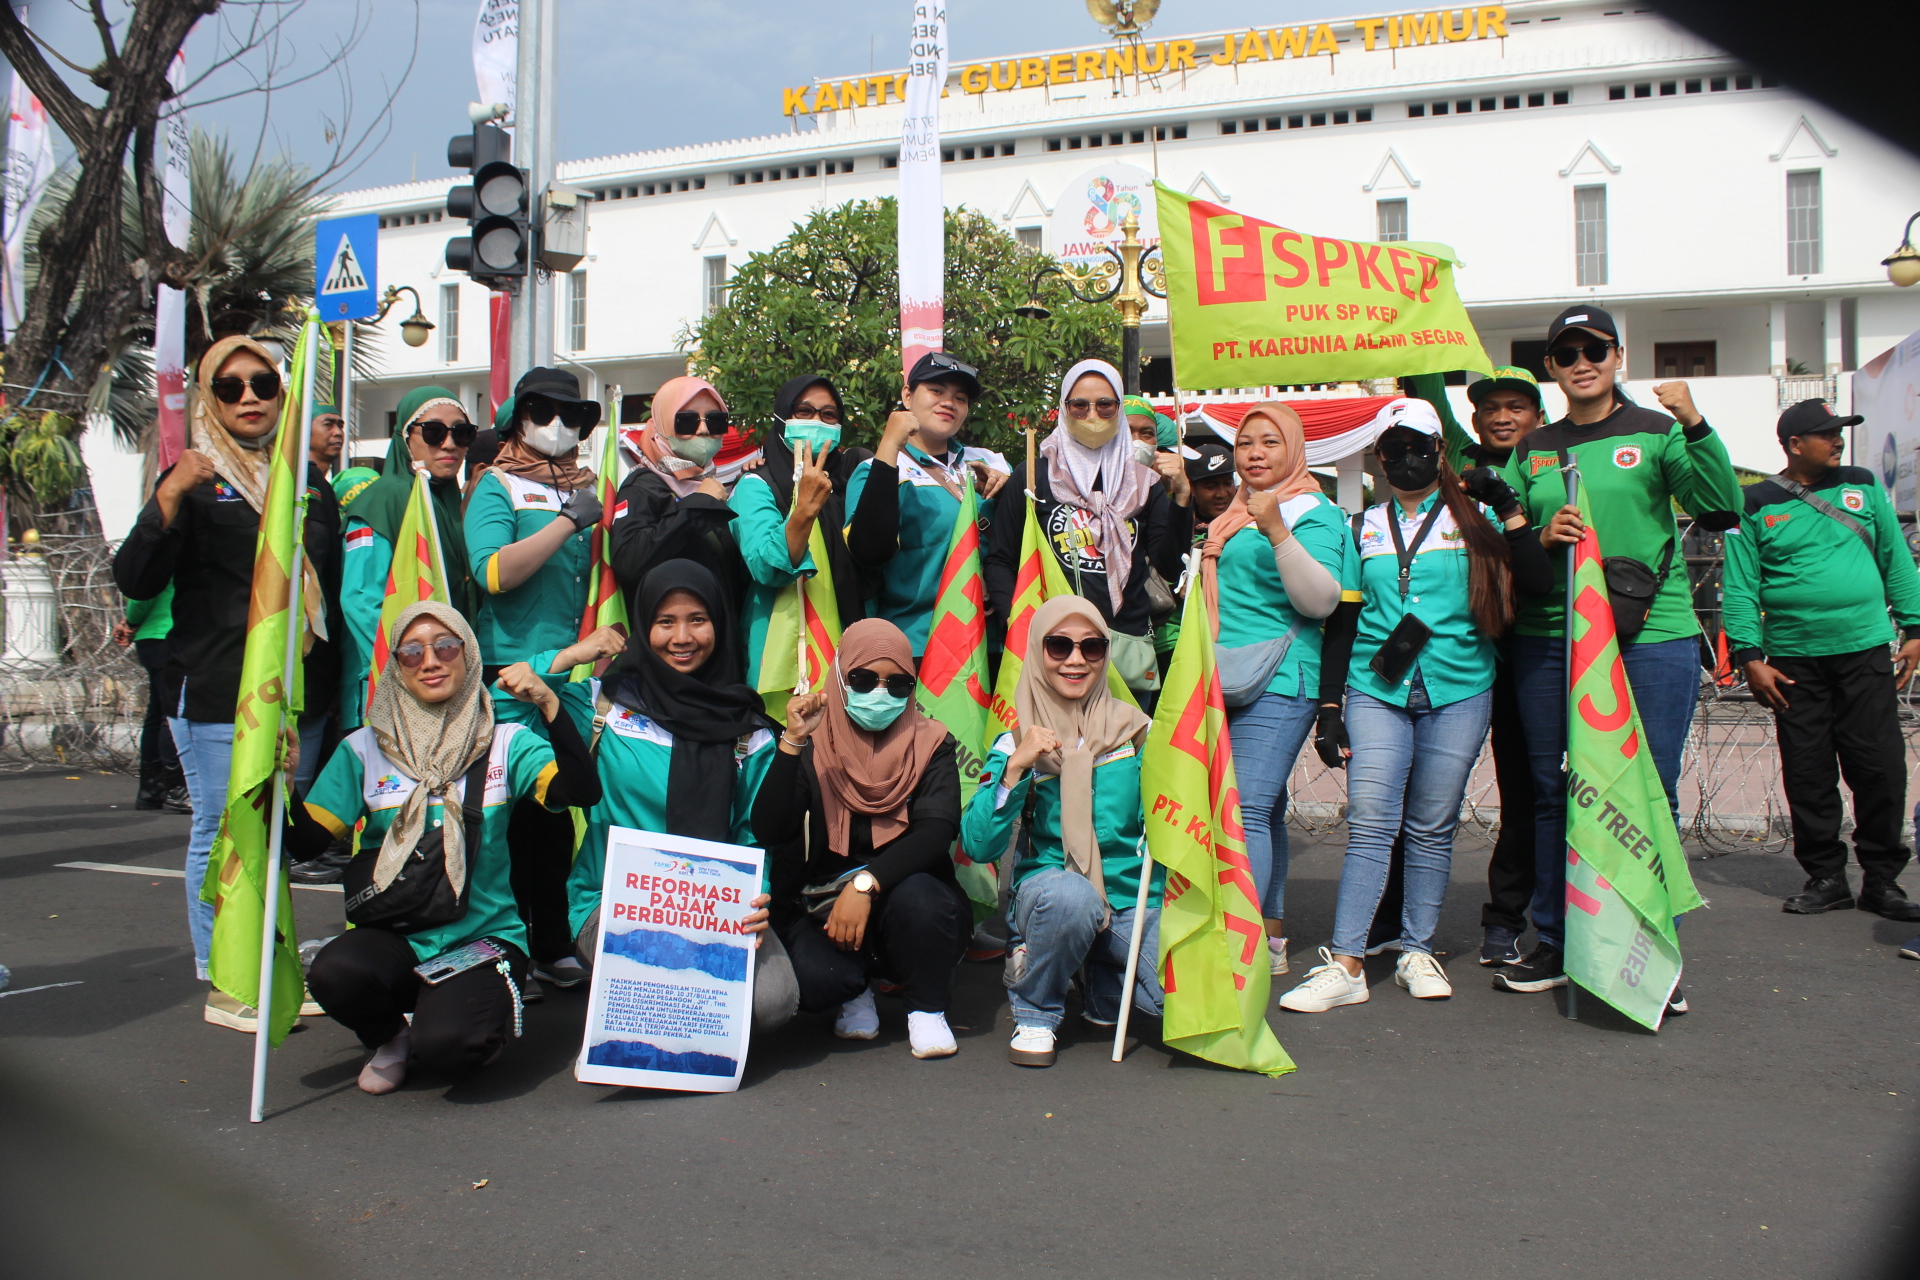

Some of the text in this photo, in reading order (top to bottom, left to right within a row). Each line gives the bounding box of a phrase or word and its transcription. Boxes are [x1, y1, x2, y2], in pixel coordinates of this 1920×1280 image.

[783, 4, 1509, 117] KANTO GUBERNUR JAWA TIMUR
[1286, 304, 1398, 325] PUK SP KEP
[1212, 329, 1469, 361] PT. KARUNIA ALAM SEGAR
[1210, 454, 1226, 465] NIKE
[614, 720, 634, 729] KSPI
[1151, 793, 1179, 828] PT.
[1596, 800, 1653, 860] TREE
[625, 872, 741, 904] REFORMASI
[650, 892, 716, 916] PAJAK
[613, 903, 746, 936] PERBURUHAN
[611, 978, 642, 987] NAIKKAN
[643, 981, 690, 992] PENGHASILAN
[634, 986, 664, 995] MENJADI
[608, 995, 703, 1011] HAPUS DISKRIMINASI PAJAK
[609, 989, 632, 997] HAPUS
[656, 995, 692, 1004] PESANGON
[606, 1007, 647, 1016] PEREMPUAN
[668, 1013, 690, 1021] SUDAH
[607, 1001, 655, 1011] PENGHASILAN
[605, 1019, 643, 1028] RATA-RATA
[703, 1029, 730, 1037] DINILAI
[606, 1013, 639, 1021] EVALUASI
[640, 1016, 678, 1026] KEBIJAKAN
